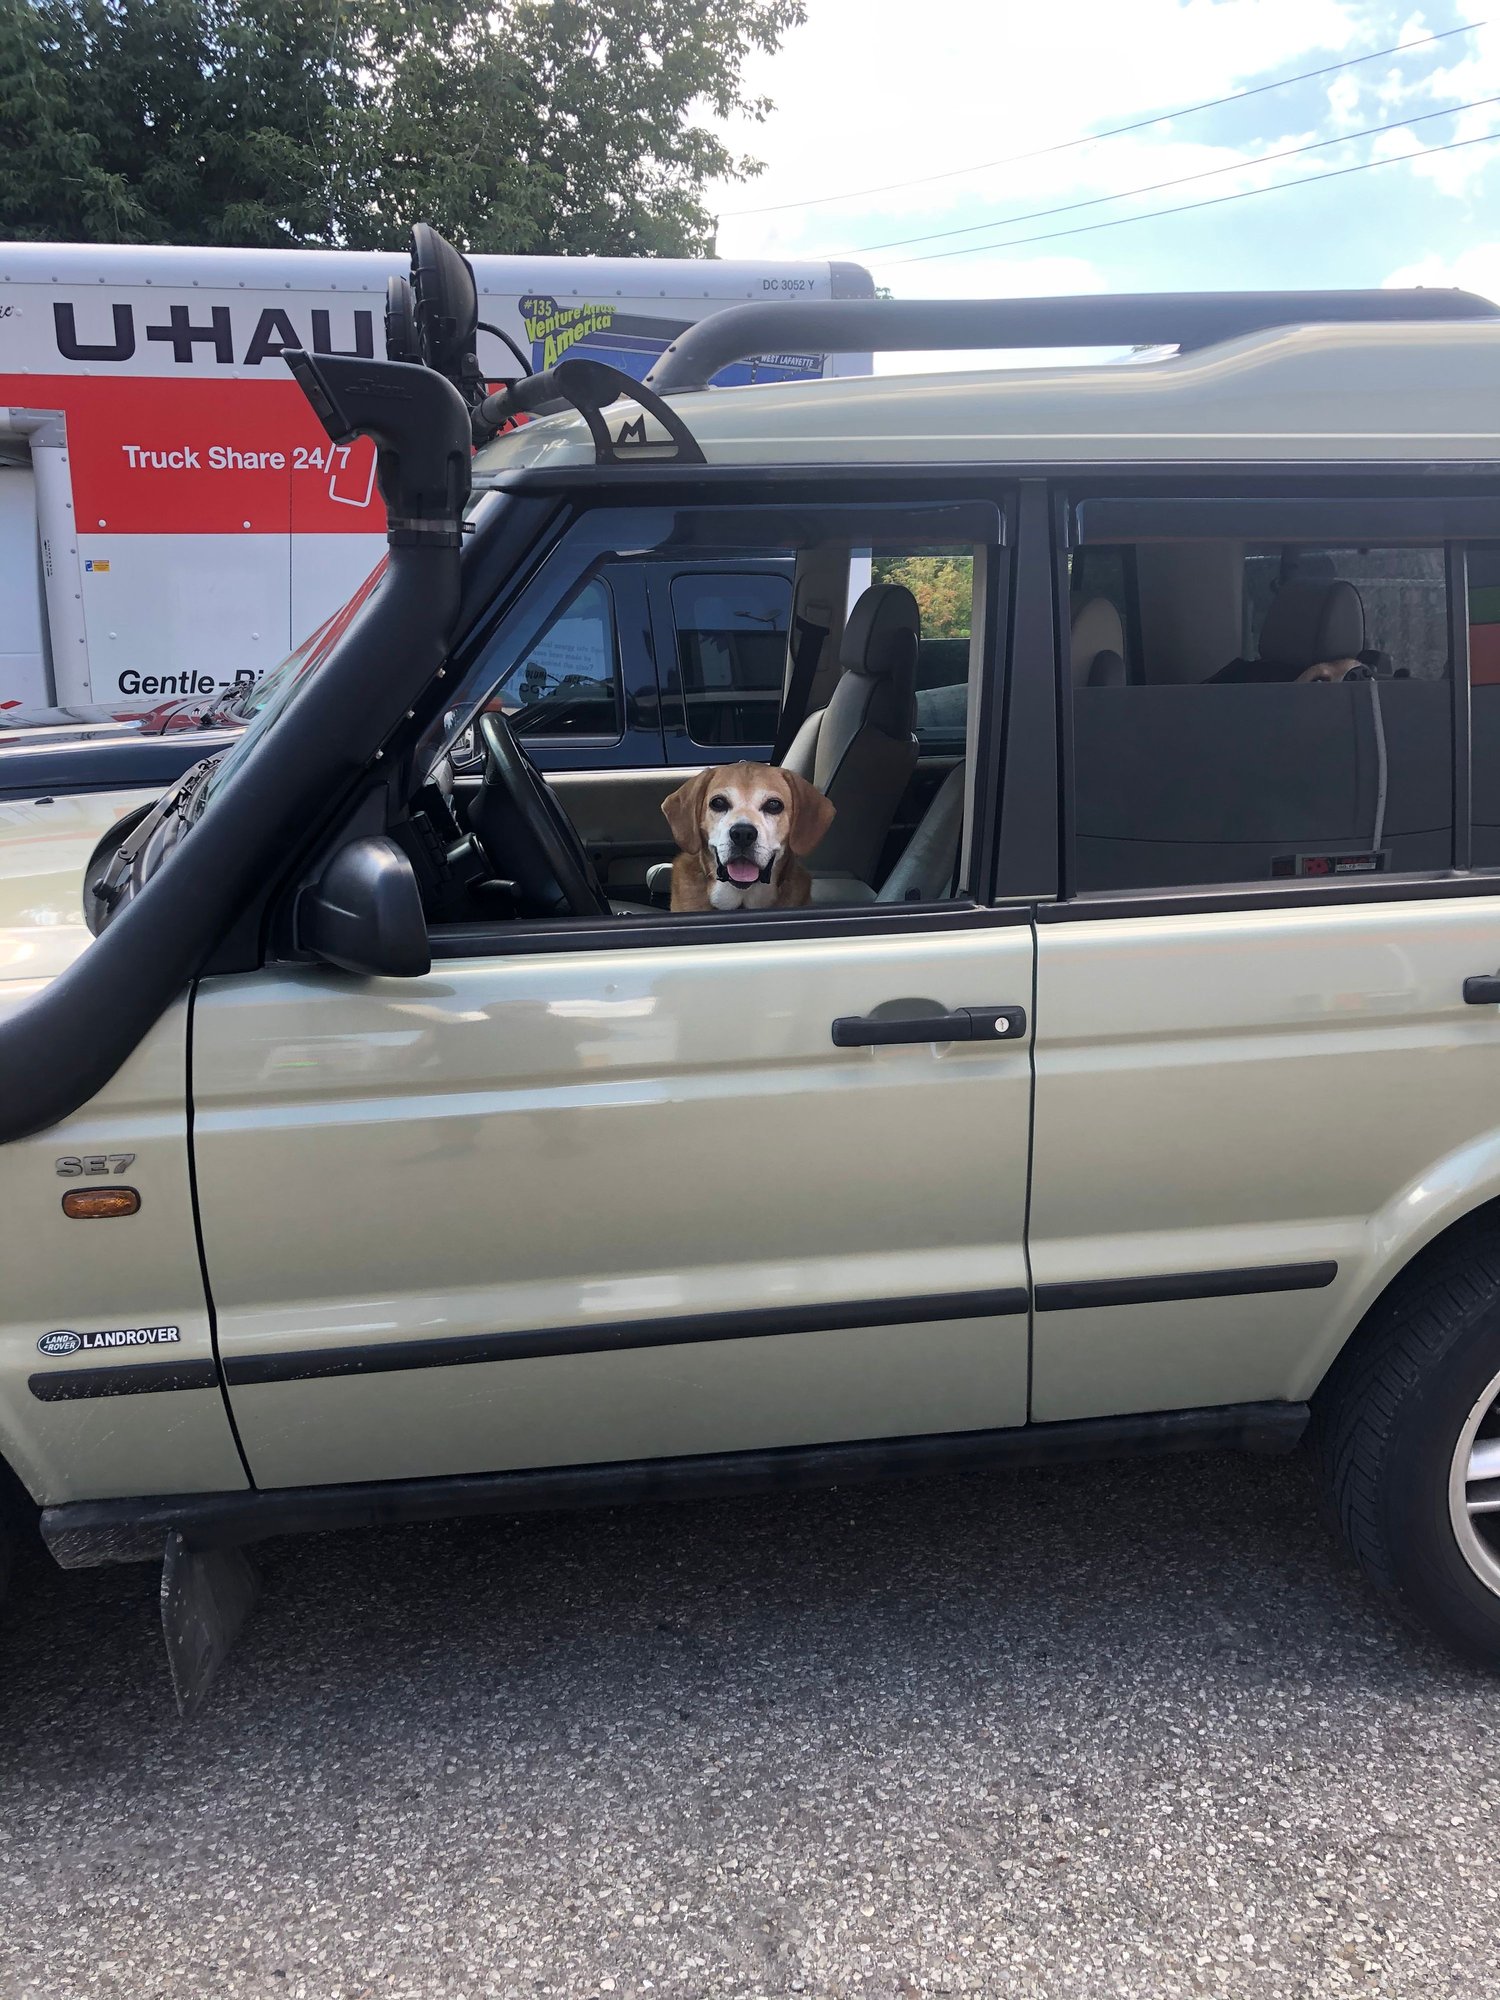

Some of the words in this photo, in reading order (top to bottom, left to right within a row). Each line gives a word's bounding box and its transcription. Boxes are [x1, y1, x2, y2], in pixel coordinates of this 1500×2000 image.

[763, 280, 779, 290] DC
[781, 280, 806, 290] 3052
[808, 280, 815, 290] Y
[523, 299, 552, 317] #135
[53, 302, 374, 365] U-HAU
[524, 308, 581, 344] Venture
[543, 315, 613, 373] America
[761, 354, 780, 364] WEST
[780, 355, 815, 367] LAFAYETTE
[122, 445, 201, 469] Truck
[208, 446, 285, 470] Share
[292, 443, 352, 473] 24/7
[55, 1153, 136, 1178] SE7
[46, 1335, 68, 1344] LAND
[48, 1342, 75, 1351] ROVER
[83, 1327, 179, 1348] LANDROVER
